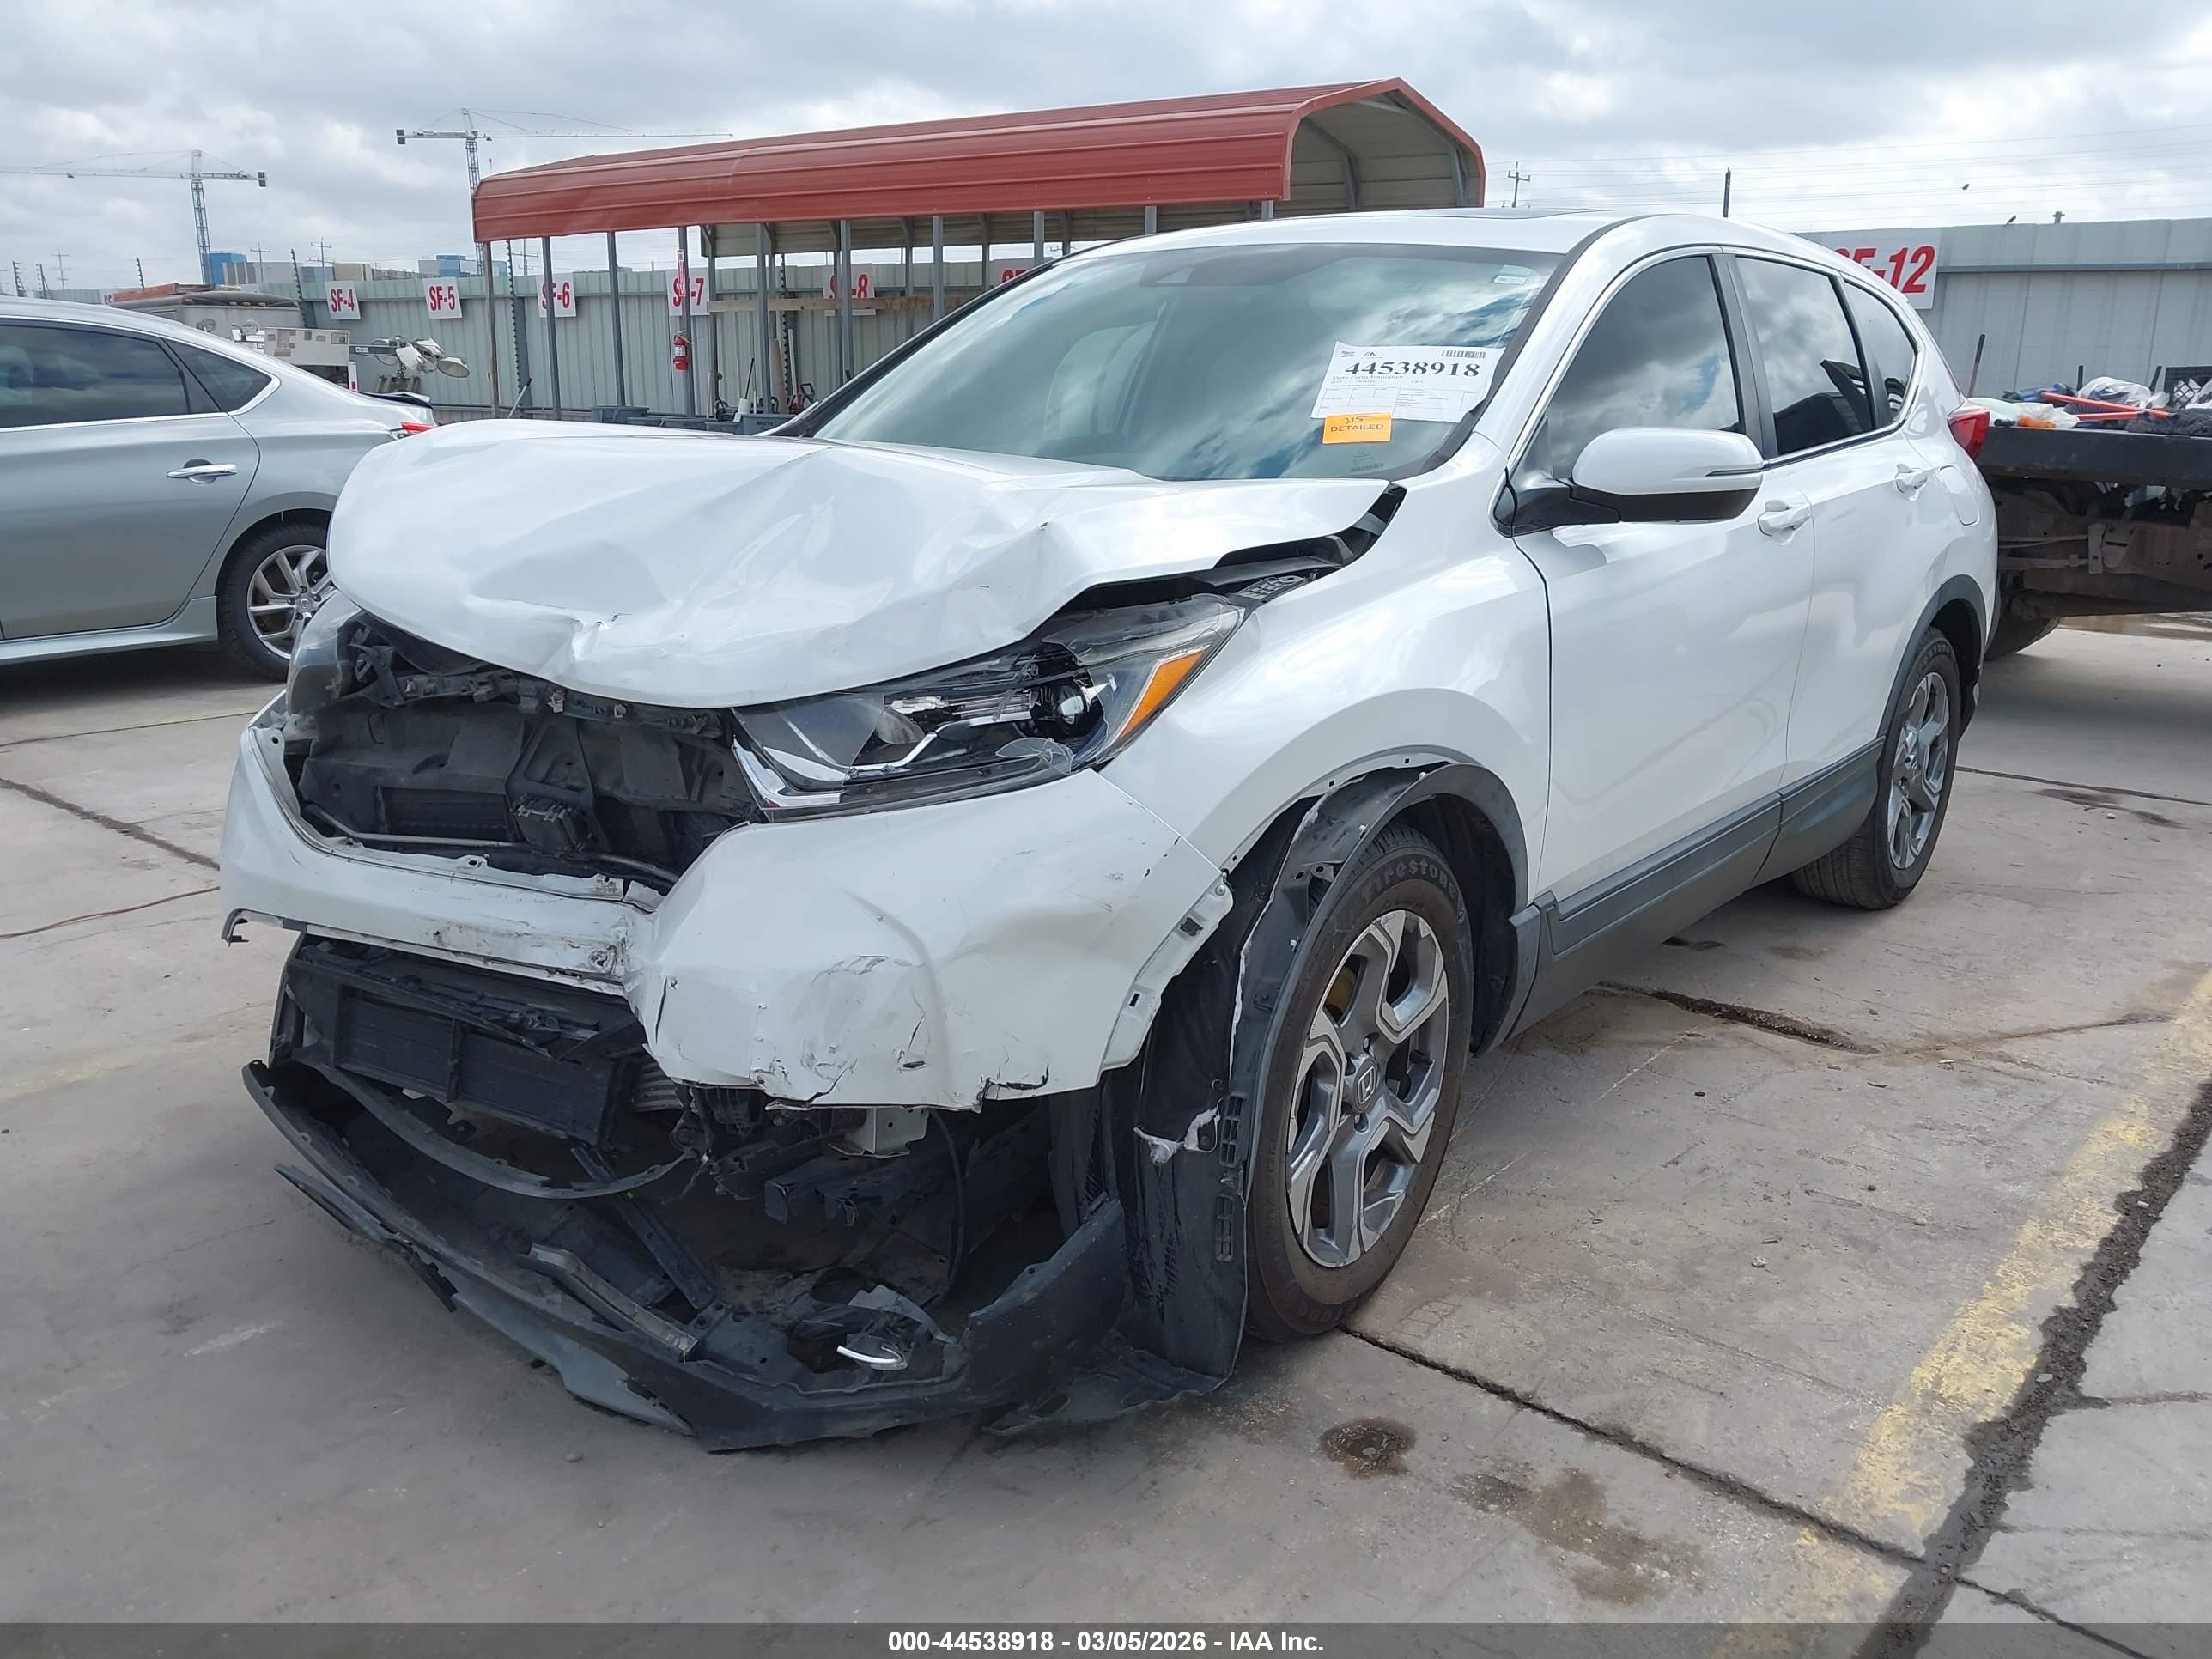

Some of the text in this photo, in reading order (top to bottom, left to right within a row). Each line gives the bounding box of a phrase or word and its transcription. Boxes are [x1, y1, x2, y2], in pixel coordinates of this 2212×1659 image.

[330, 288, 355, 313] SF-4
[428, 285, 456, 311] SF-5
[1345, 362, 1480, 377] 44538918
[1330, 423, 1384, 433] DETAILED
[1361, 858, 1456, 903] Firestone
